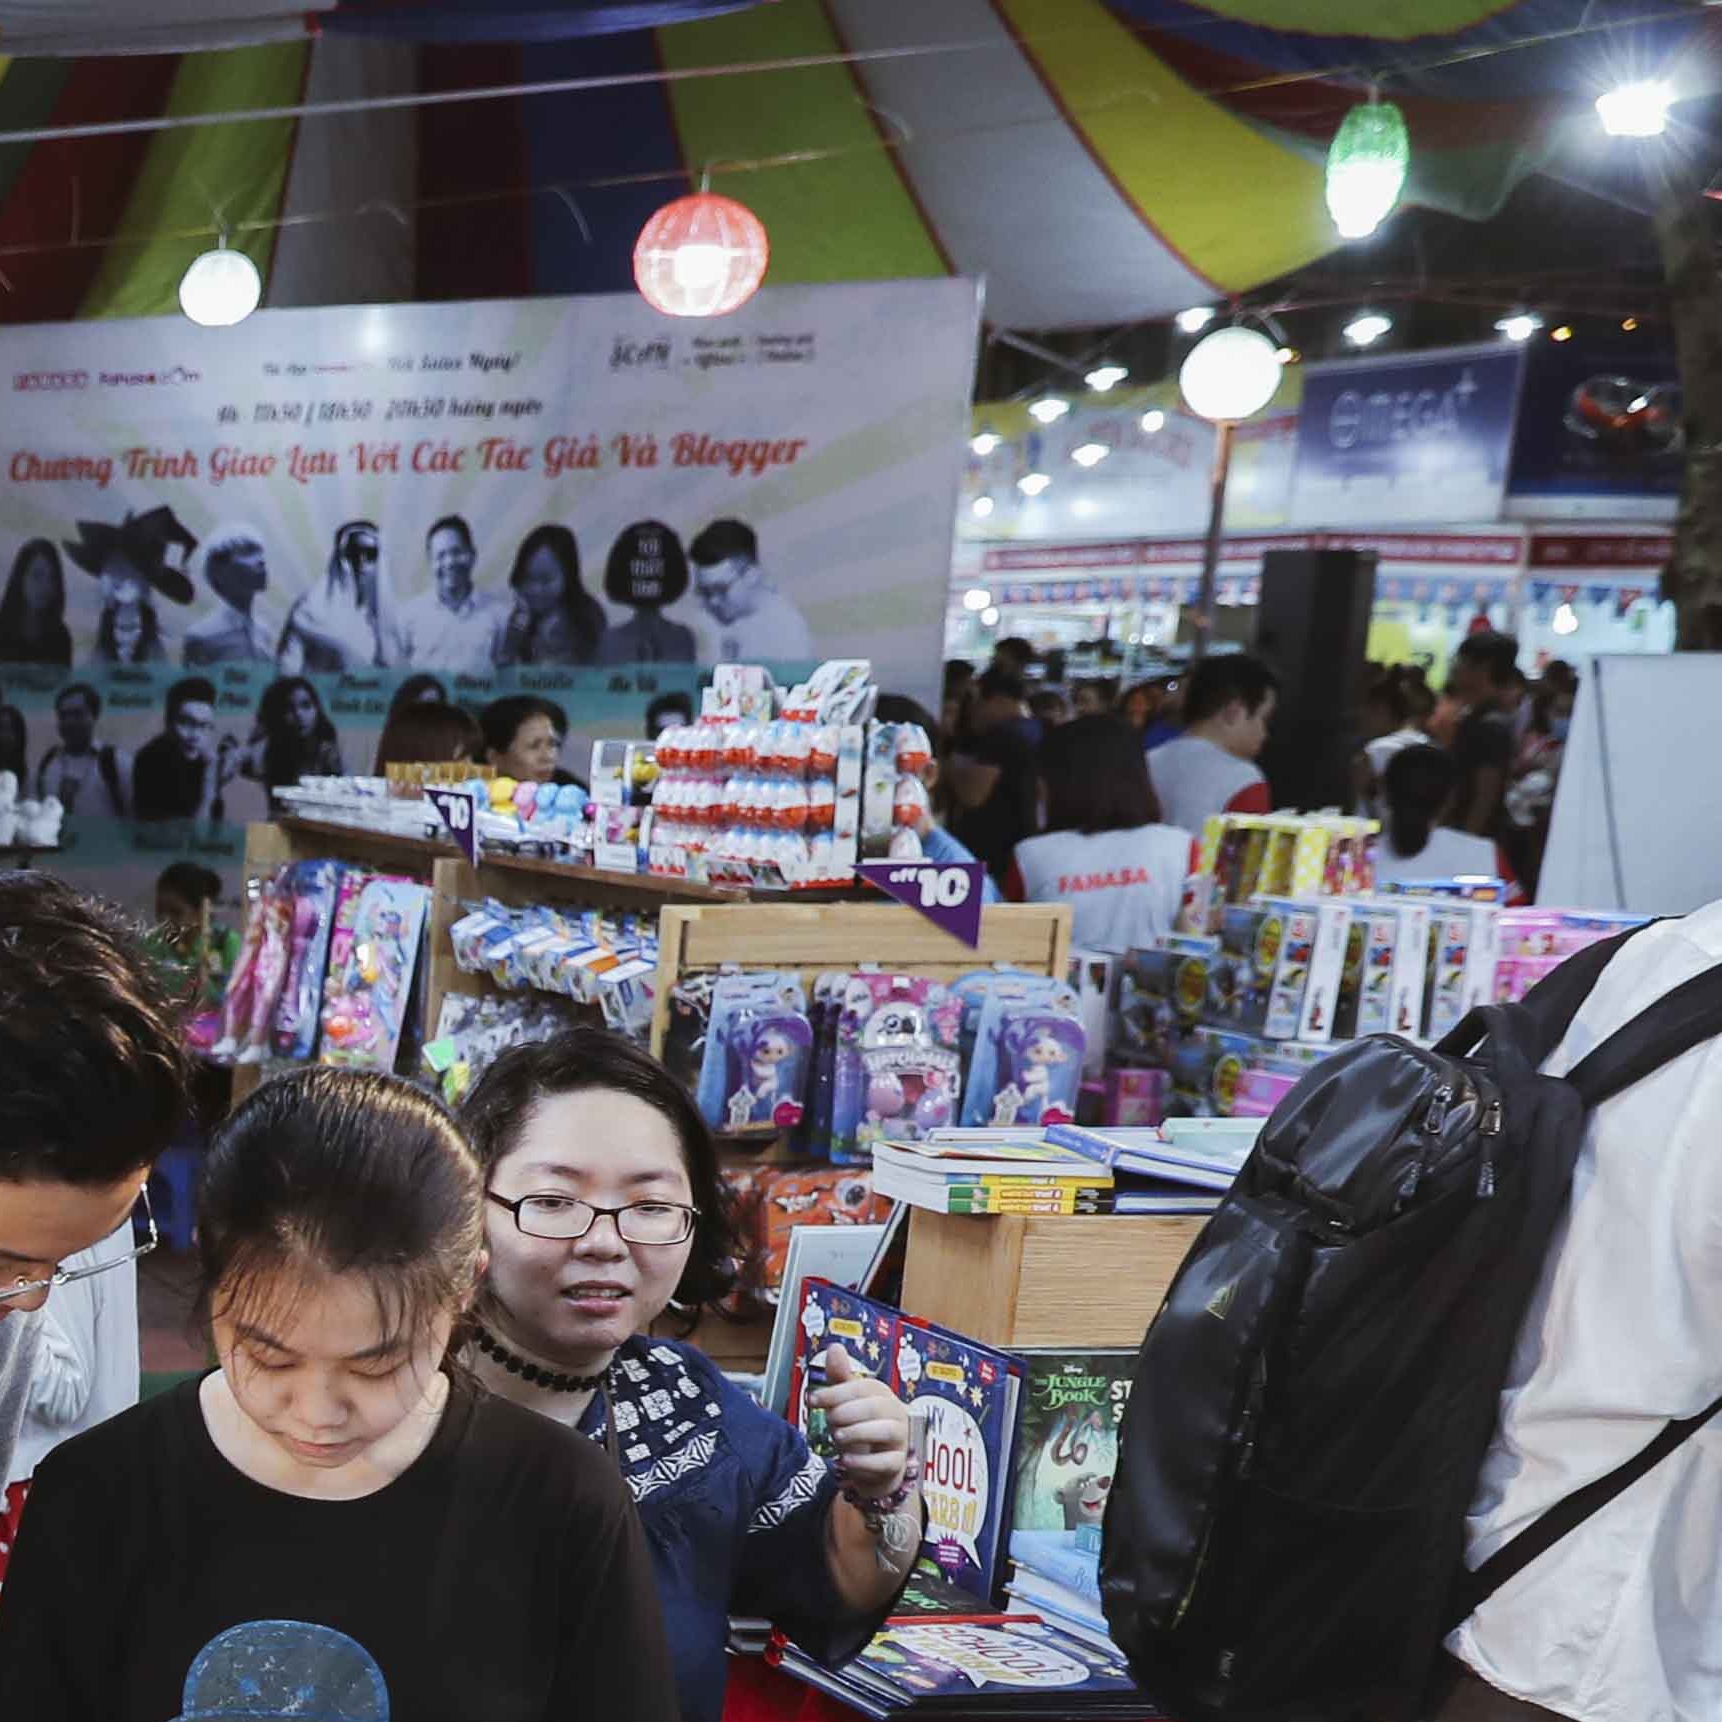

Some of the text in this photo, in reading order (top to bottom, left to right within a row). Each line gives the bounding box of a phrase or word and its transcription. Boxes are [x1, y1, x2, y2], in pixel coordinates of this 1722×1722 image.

[9, 447, 114, 488] Chương
[210, 446, 277, 486] Giao
[287, 443, 339, 485] Lưu
[411, 440, 466, 473] Các
[475, 435, 531, 472] Tác
[542, 434, 600, 478] Giả
[670, 432, 809, 477] Blogger
[889, 870, 918, 885] off
[1058, 867, 1151, 894] FAHASA
[1044, 1374, 1107, 1394] JUNGLE
[921, 1434, 977, 1494] HOOL
